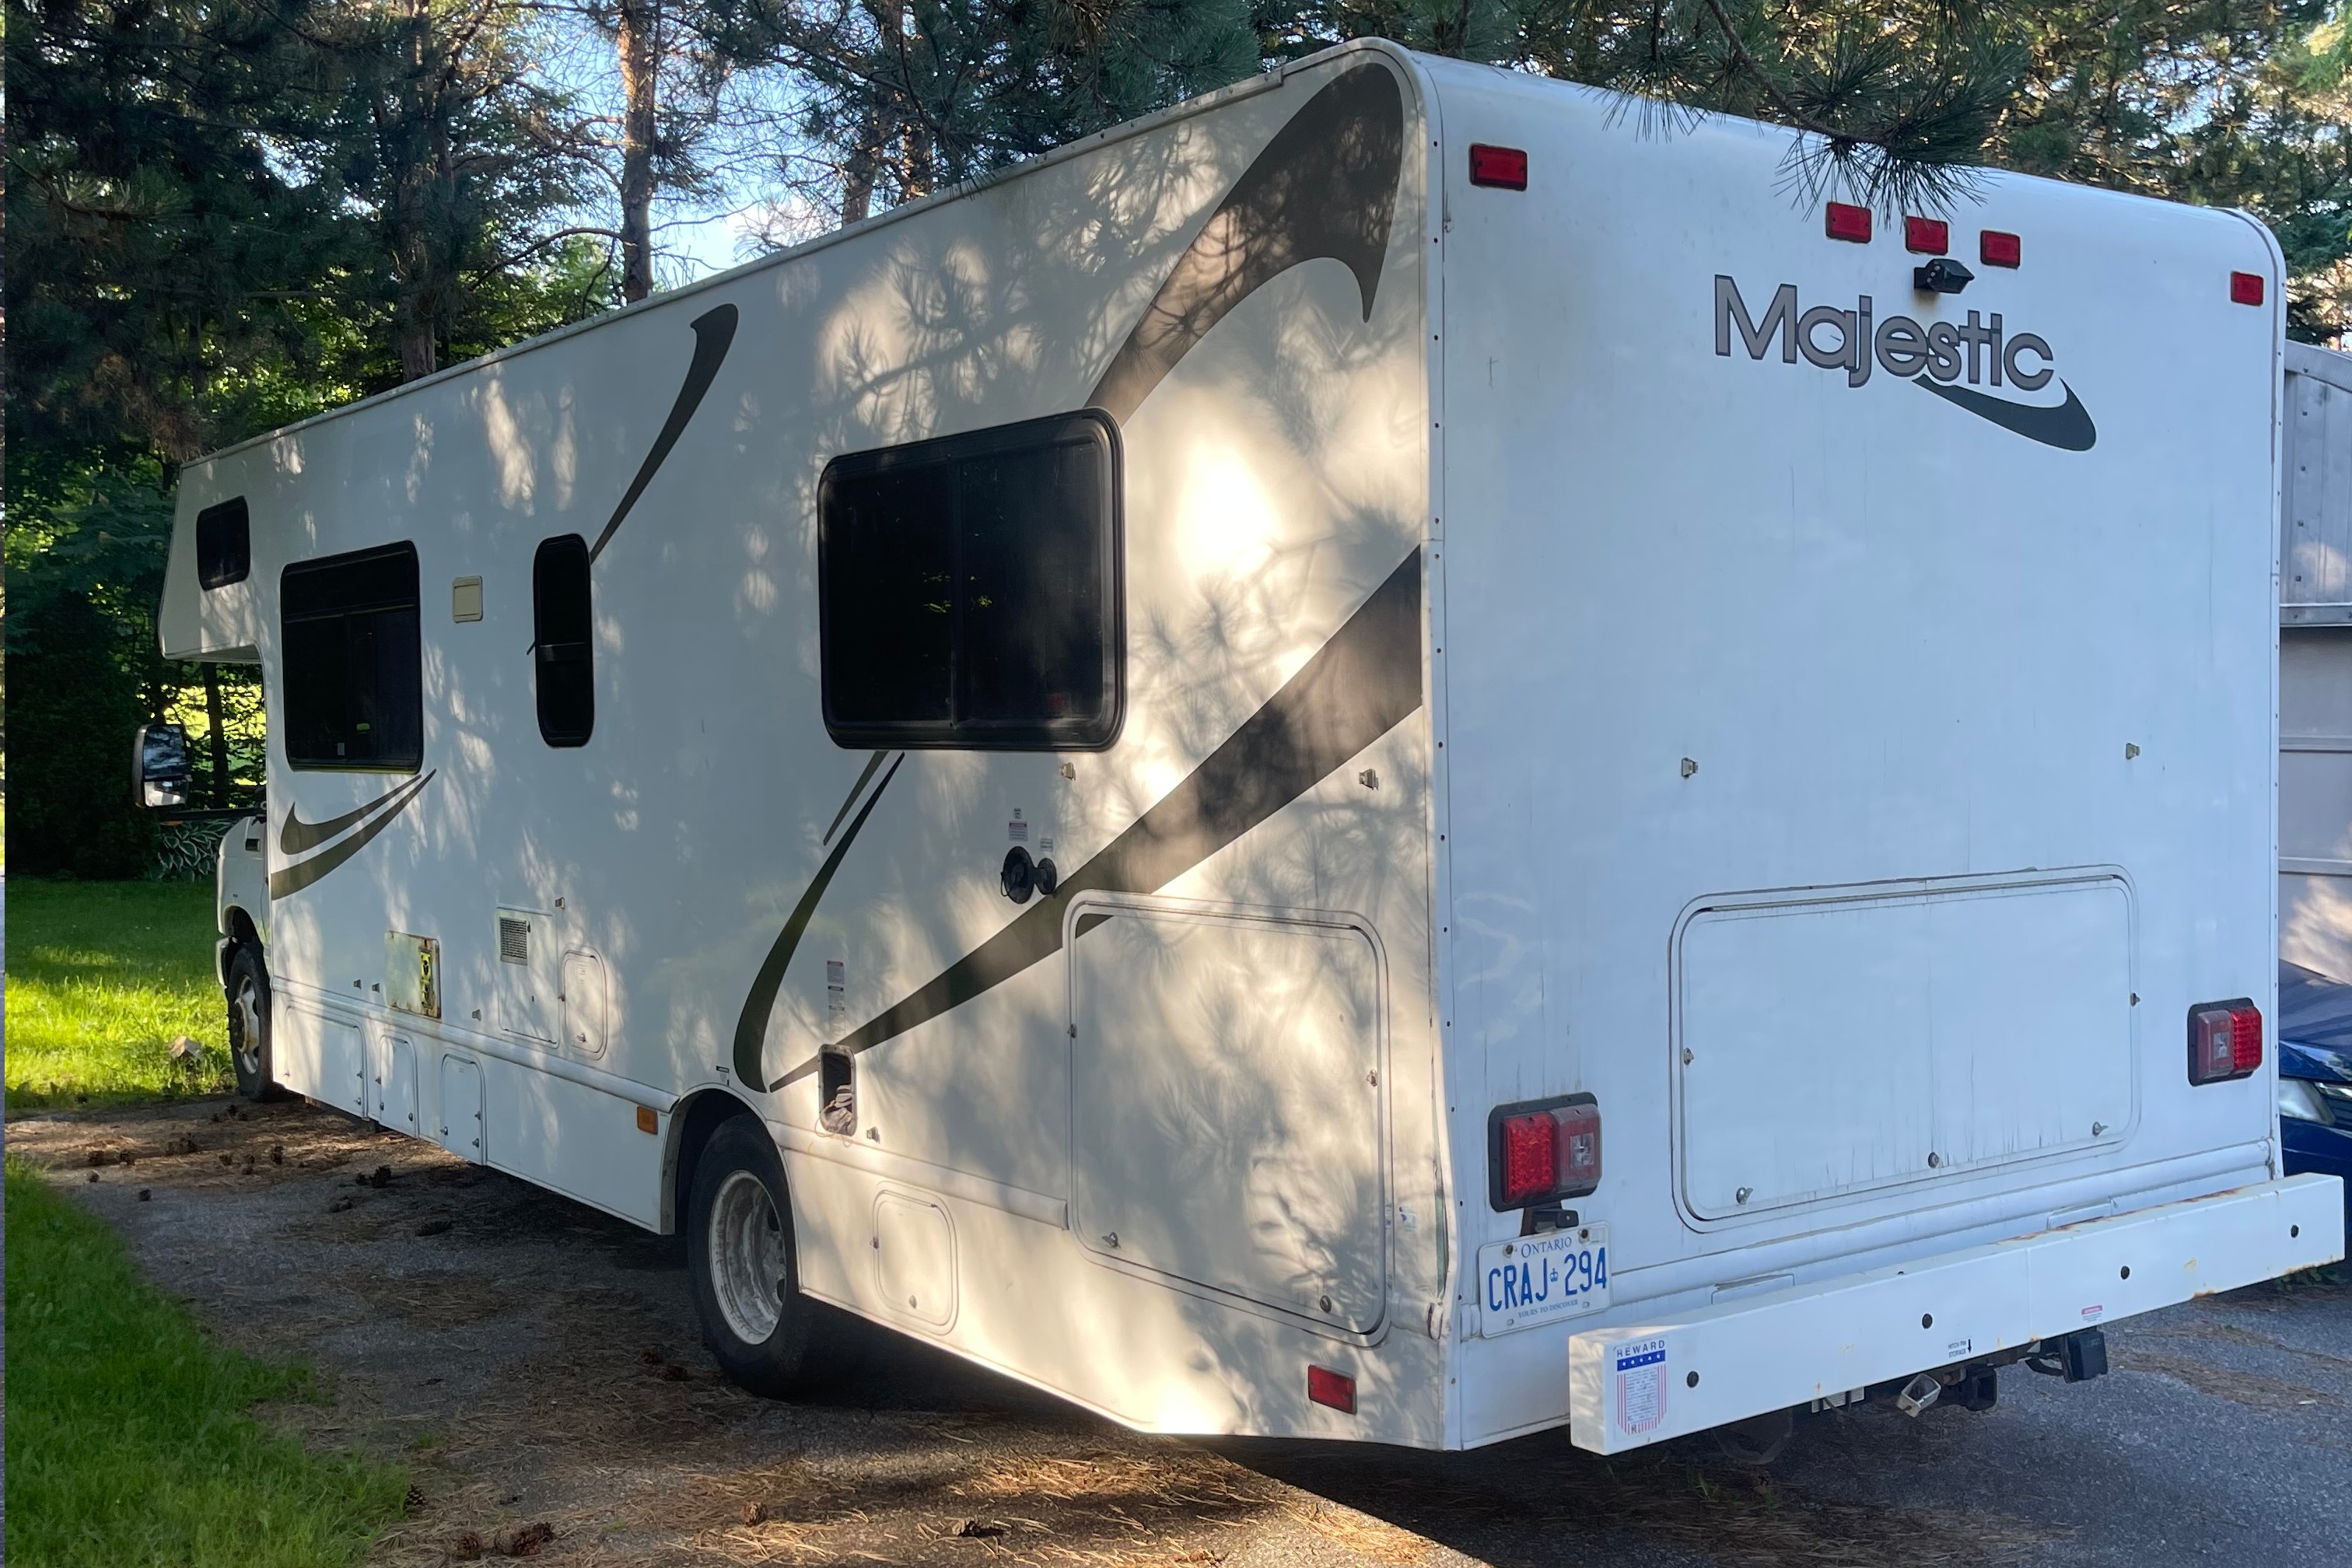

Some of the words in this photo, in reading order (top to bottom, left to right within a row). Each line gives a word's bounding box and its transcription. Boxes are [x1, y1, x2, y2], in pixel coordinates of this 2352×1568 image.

[1714, 274, 2054, 391] Majestic
[1521, 1237, 1572, 1258] ONTARIO
[1488, 1258, 1548, 1312] CRAJ
[1563, 1247, 1607, 1297] 294
[1518, 1308, 1538, 1318] YOURS
[1549, 1299, 1578, 1311] DISCOVER
[1617, 1340, 1665, 1358] REWARD
